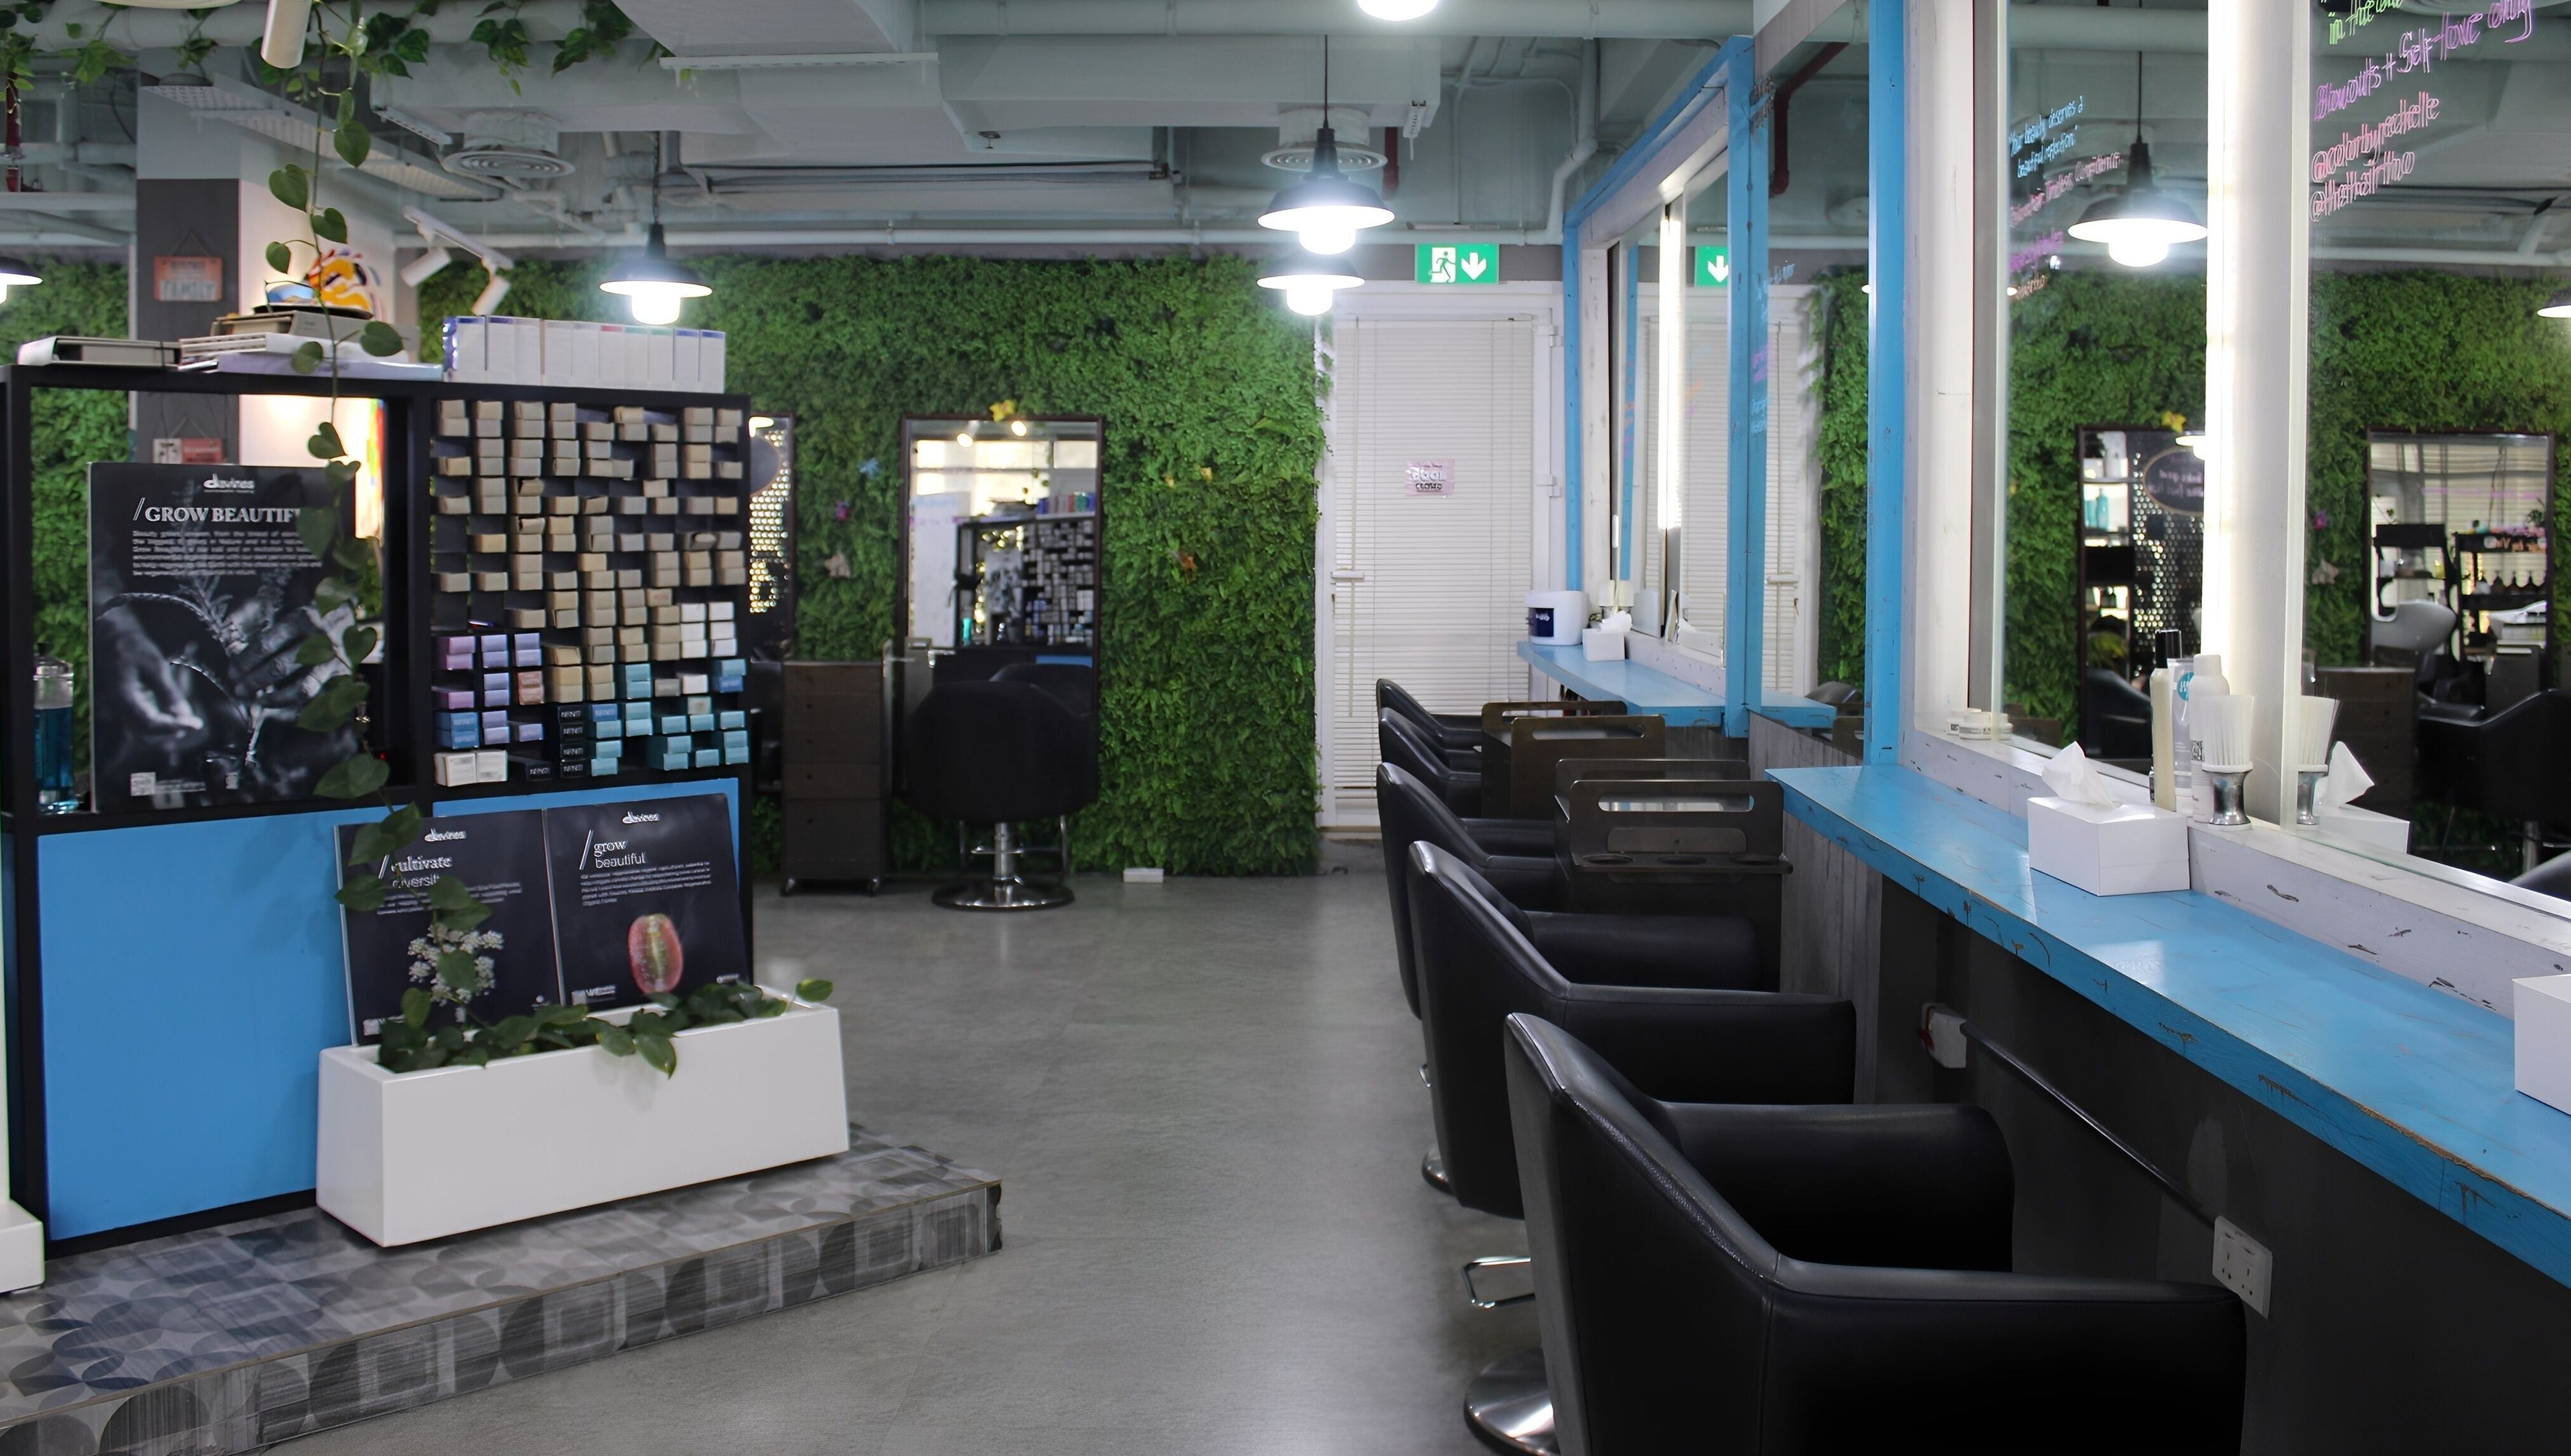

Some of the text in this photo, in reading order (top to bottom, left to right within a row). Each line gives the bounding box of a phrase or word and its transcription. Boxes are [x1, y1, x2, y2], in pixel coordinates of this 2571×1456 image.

[211, 507, 301, 523] BEAUTIF
[593, 840, 628, 858] grow
[595, 852, 646, 869] beautiful
